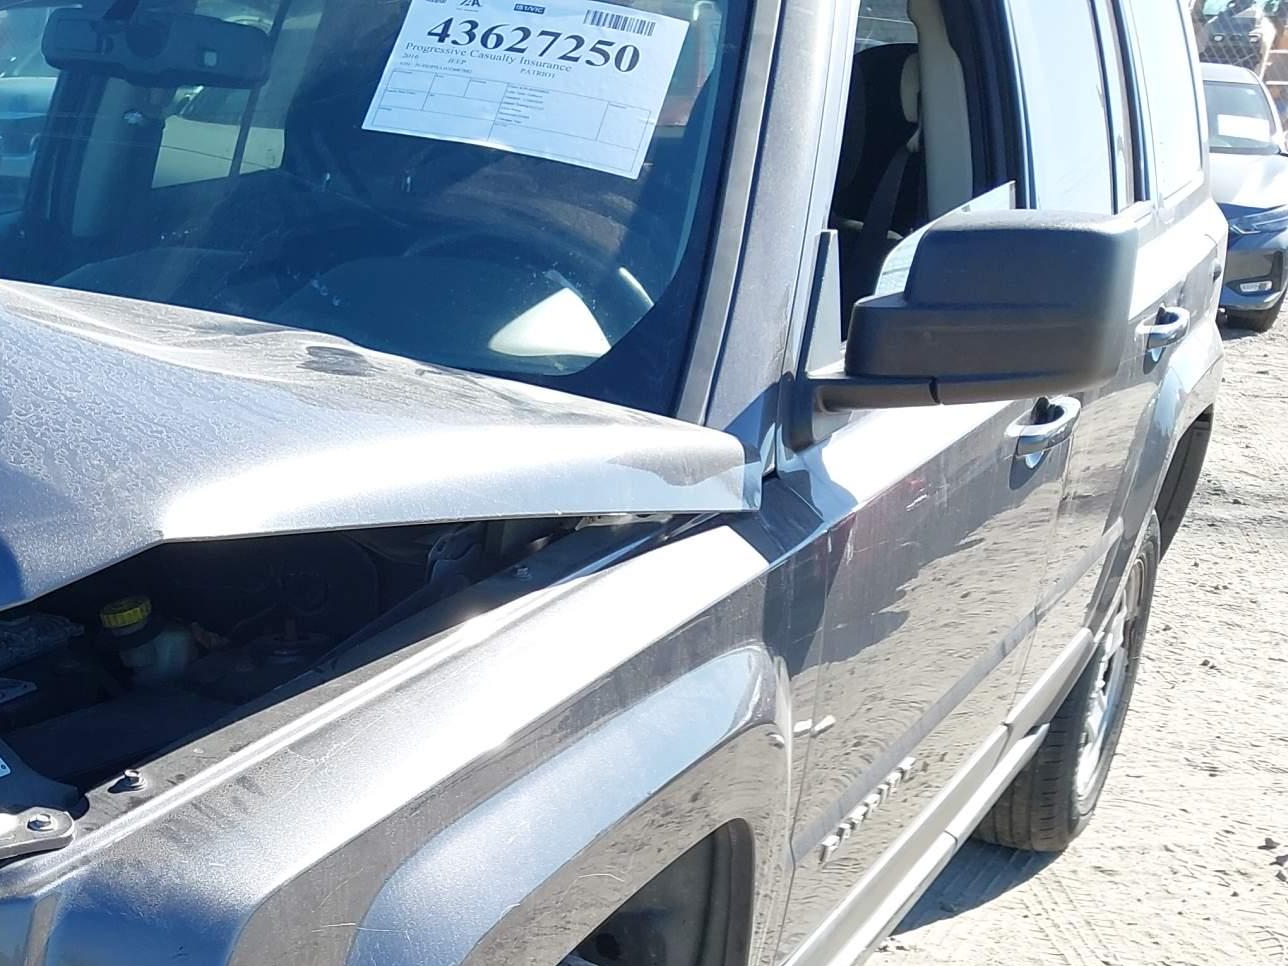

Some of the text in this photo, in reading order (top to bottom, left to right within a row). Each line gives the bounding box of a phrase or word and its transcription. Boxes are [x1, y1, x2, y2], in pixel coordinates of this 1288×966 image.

[405, 42, 572, 72] Progressive Casualty Insurance
[427, 17, 640, 73] 43627250
